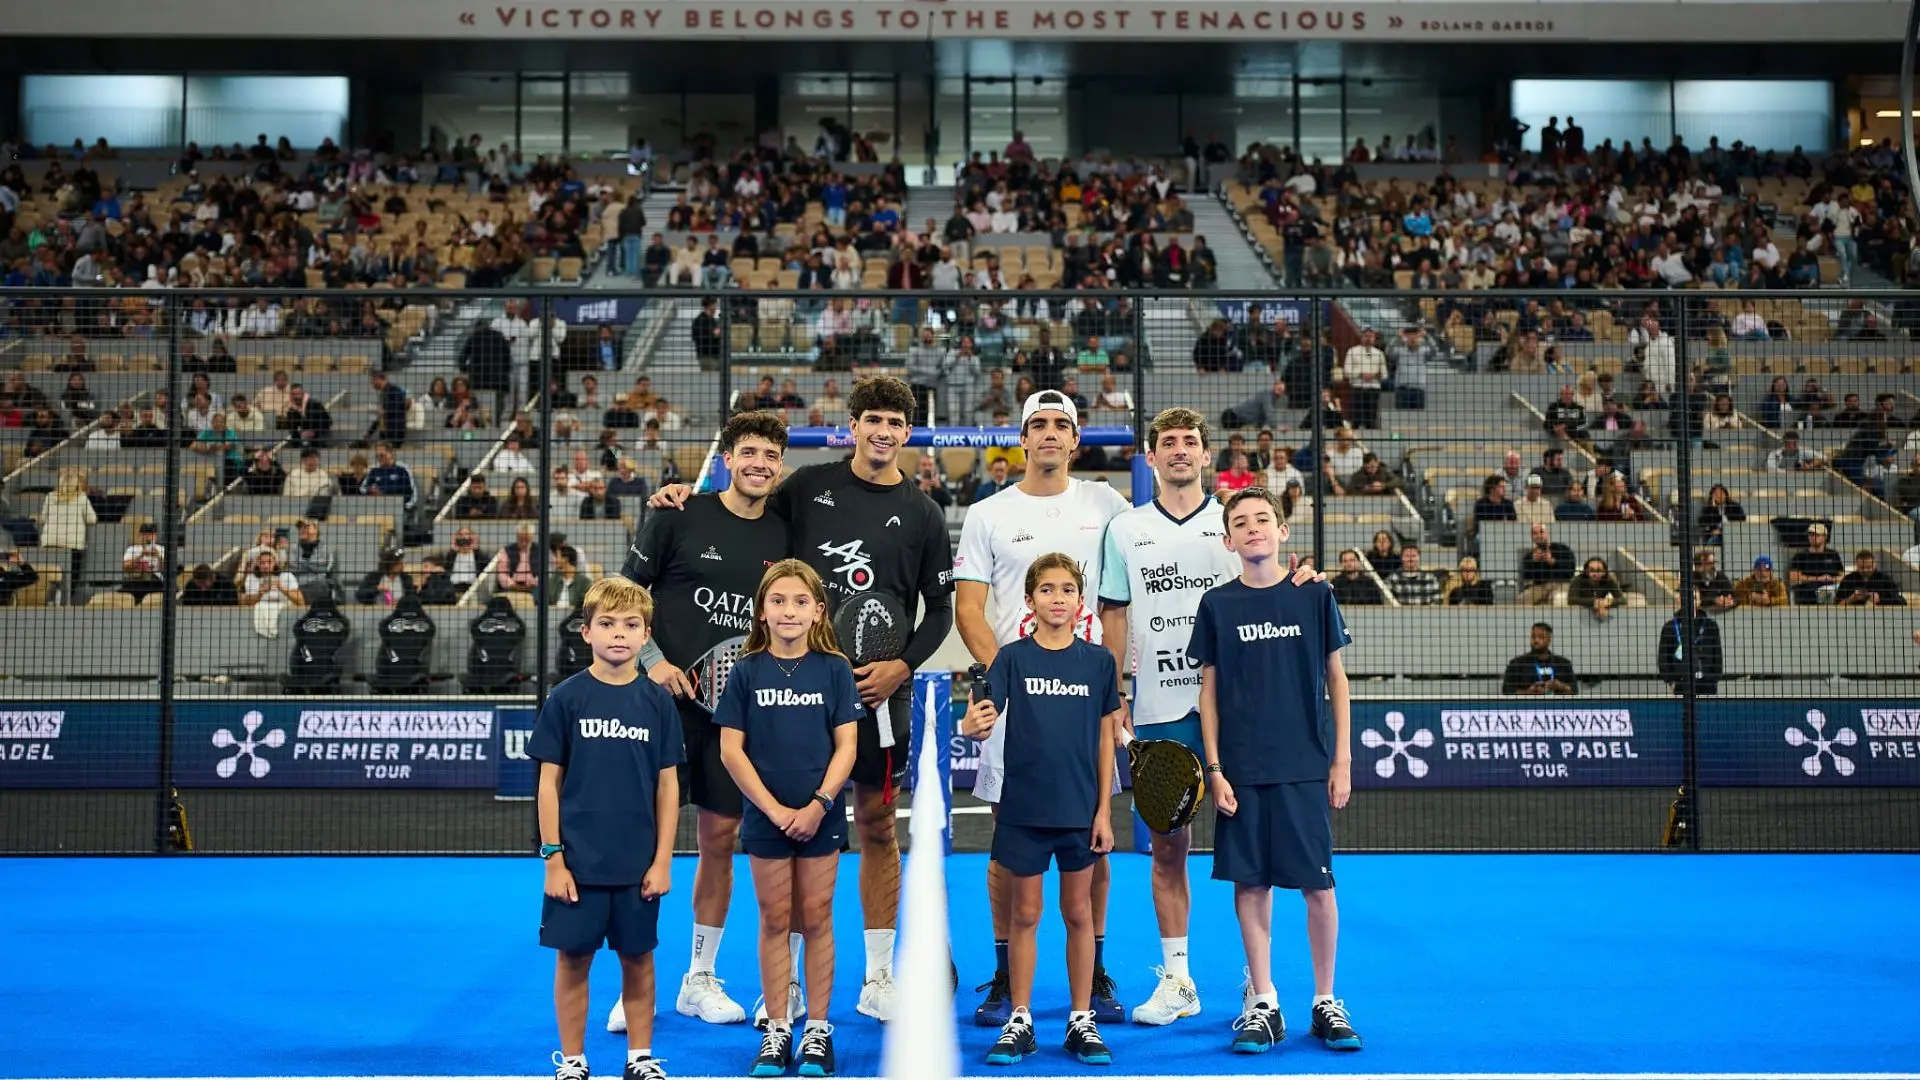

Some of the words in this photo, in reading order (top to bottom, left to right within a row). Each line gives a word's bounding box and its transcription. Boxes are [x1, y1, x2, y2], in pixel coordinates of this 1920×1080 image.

[496, 8, 662, 28] VICTORY
[685, 10, 854, 28] BELONGS
[877, 10, 919, 28] TO
[942, 10, 1009, 29] THE
[1033, 10, 1130, 29] MOST
[1150, 10, 1366, 30] TENACIOUS
[1420, 20, 1483, 31] ROLAND
[1492, 20, 1554, 31] GARROS
[932, 434, 966, 447] GIVES
[968, 434, 992, 447] YOU
[1140, 562, 1178, 581] Padel
[820, 579, 856, 596] LPIN
[1145, 575, 1214, 596] PROShop
[694, 586, 754, 617] QATA
[708, 612, 752, 632] AIRWA
[1236, 622, 1301, 642] Wilson
[1025, 677, 1090, 697] Wilson
[755, 688, 824, 707] Wilson
[0, 714, 58, 732] WAYS
[303, 714, 381, 734] QATAR
[389, 714, 487, 732] AIRWAYS
[579, 718, 650, 742] Wilson
[1446, 714, 1523, 733] QATAR
[1530, 714, 1628, 732] AIRWAYS
[293, 742, 400, 760] PREMIER
[410, 742, 487, 760] PADEL
[1445, 742, 1551, 759] PREMIER
[1560, 741, 1638, 759] PADEL
[364, 765, 412, 779] TOUR
[1521, 763, 1569, 778] TOUR
